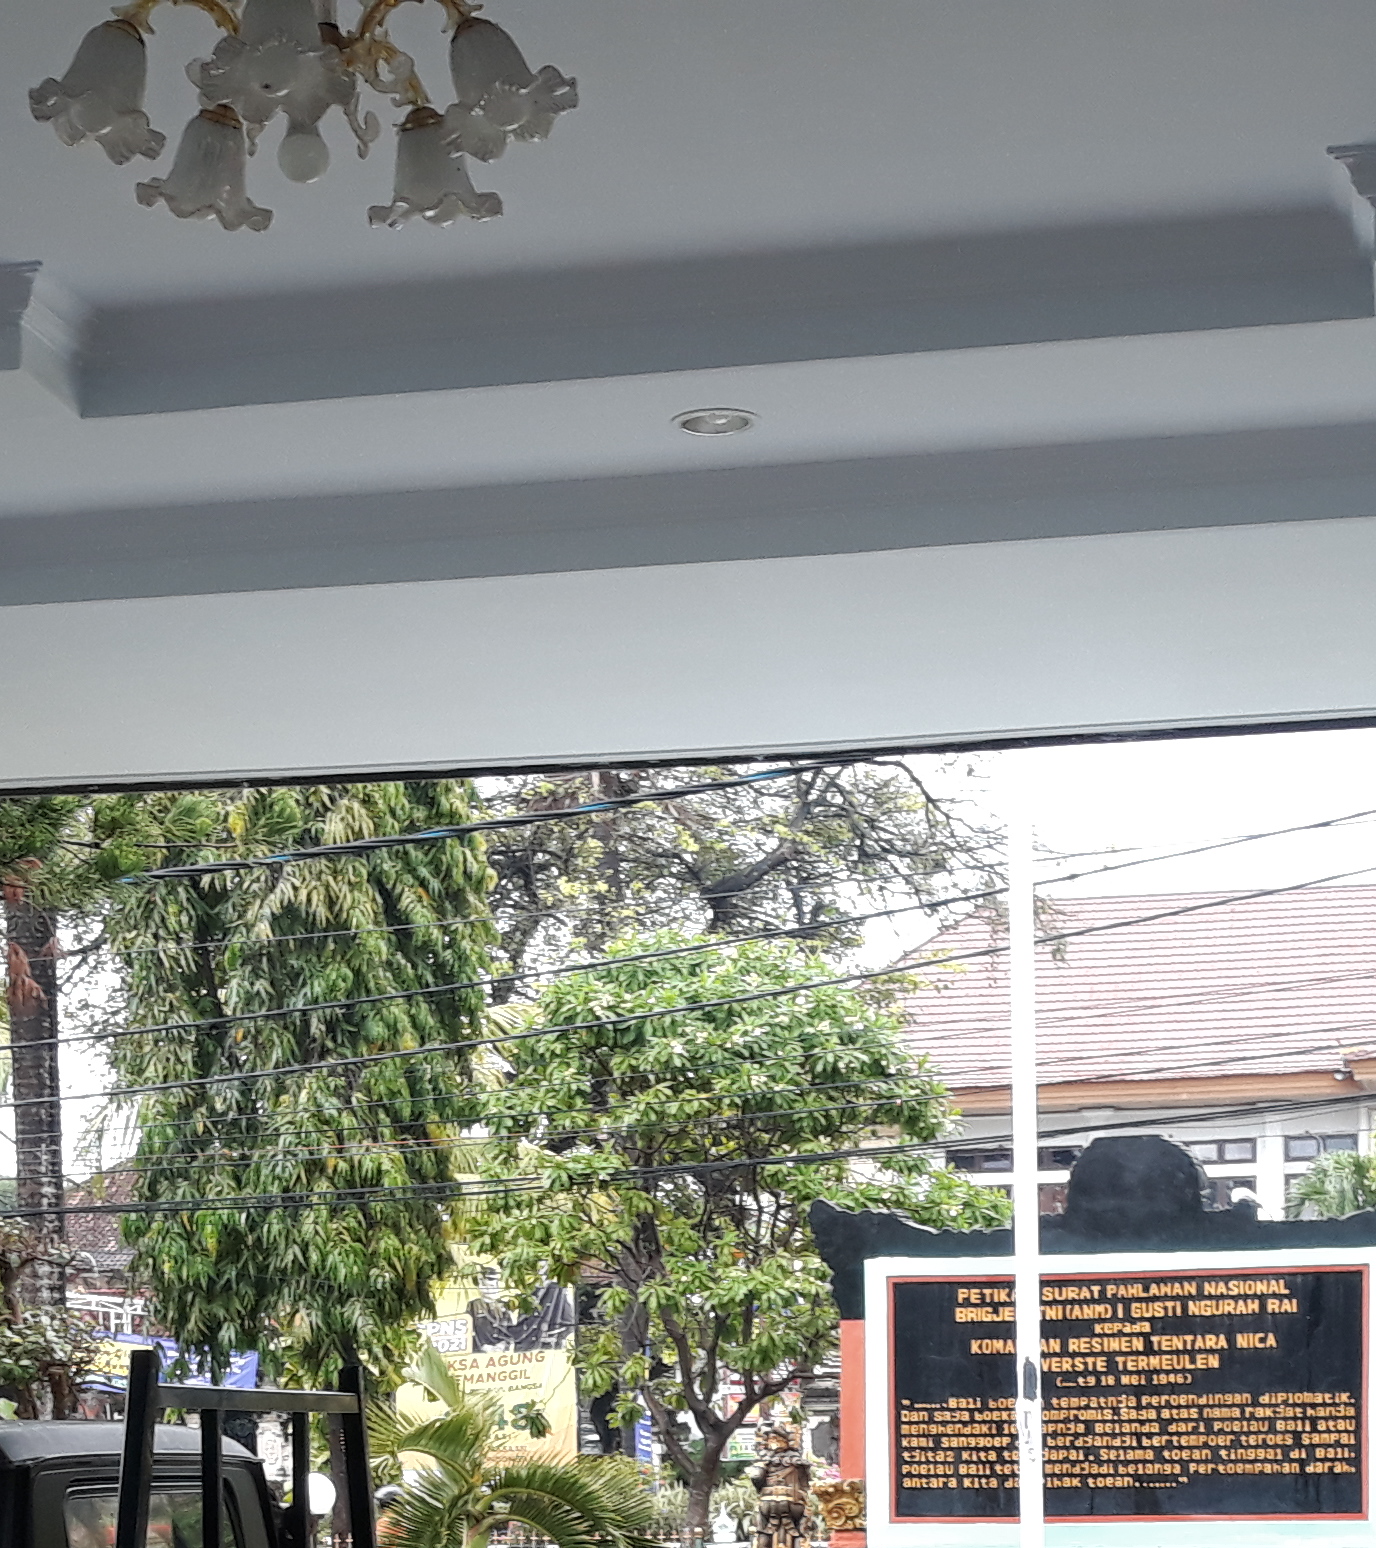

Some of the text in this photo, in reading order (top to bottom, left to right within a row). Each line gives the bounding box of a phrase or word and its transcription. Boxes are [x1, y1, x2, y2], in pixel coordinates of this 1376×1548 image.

[1042, 1286, 1101, 1301] SURAT
[1106, 1281, 1197, 1298] PAHLAWAN
[1204, 1279, 1290, 1296] NASIONAL
[955, 1307, 1015, 1323] BRIGJE
[1117, 1303, 1123, 1318] I
[1130, 1301, 1182, 1318] GUSTI
[1188, 1299, 1260, 1316] NGURAH
[1267, 1299, 1298, 1313] RAI
[426, 1319, 467, 1336] PNS
[971, 1333, 1277, 1354] KOMAAN RESIMEN TENTARA NICA
[447, 1351, 545, 1371] KSA AGUNG
[1041, 1354, 1219, 1372] VERSTE TERMEULEN
[454, 1369, 531, 1384] EMANGGIL
[1101, 1375, 1115, 1386] 18
[1152, 1374, 1192, 1385] 1946)
[901, 1410, 928, 1421] Dan
[1161, 1407, 1199, 1419] atas
[1203, 1407, 1241, 1418] nama
[1094, 1421, 1160, 1433] Belanda
[1168, 1421, 1205, 1432] dari
[1276, 1420, 1311, 1431] Bali
[1239, 1434, 1293, 1445] teroes
[1162, 1449, 1211, 1460] toean
[1219, 1448, 1283, 1460] tinggal
[1289, 1448, 1307, 1459] di
[958, 1464, 990, 1475] Bali
[902, 1477, 957, 1489] antara
